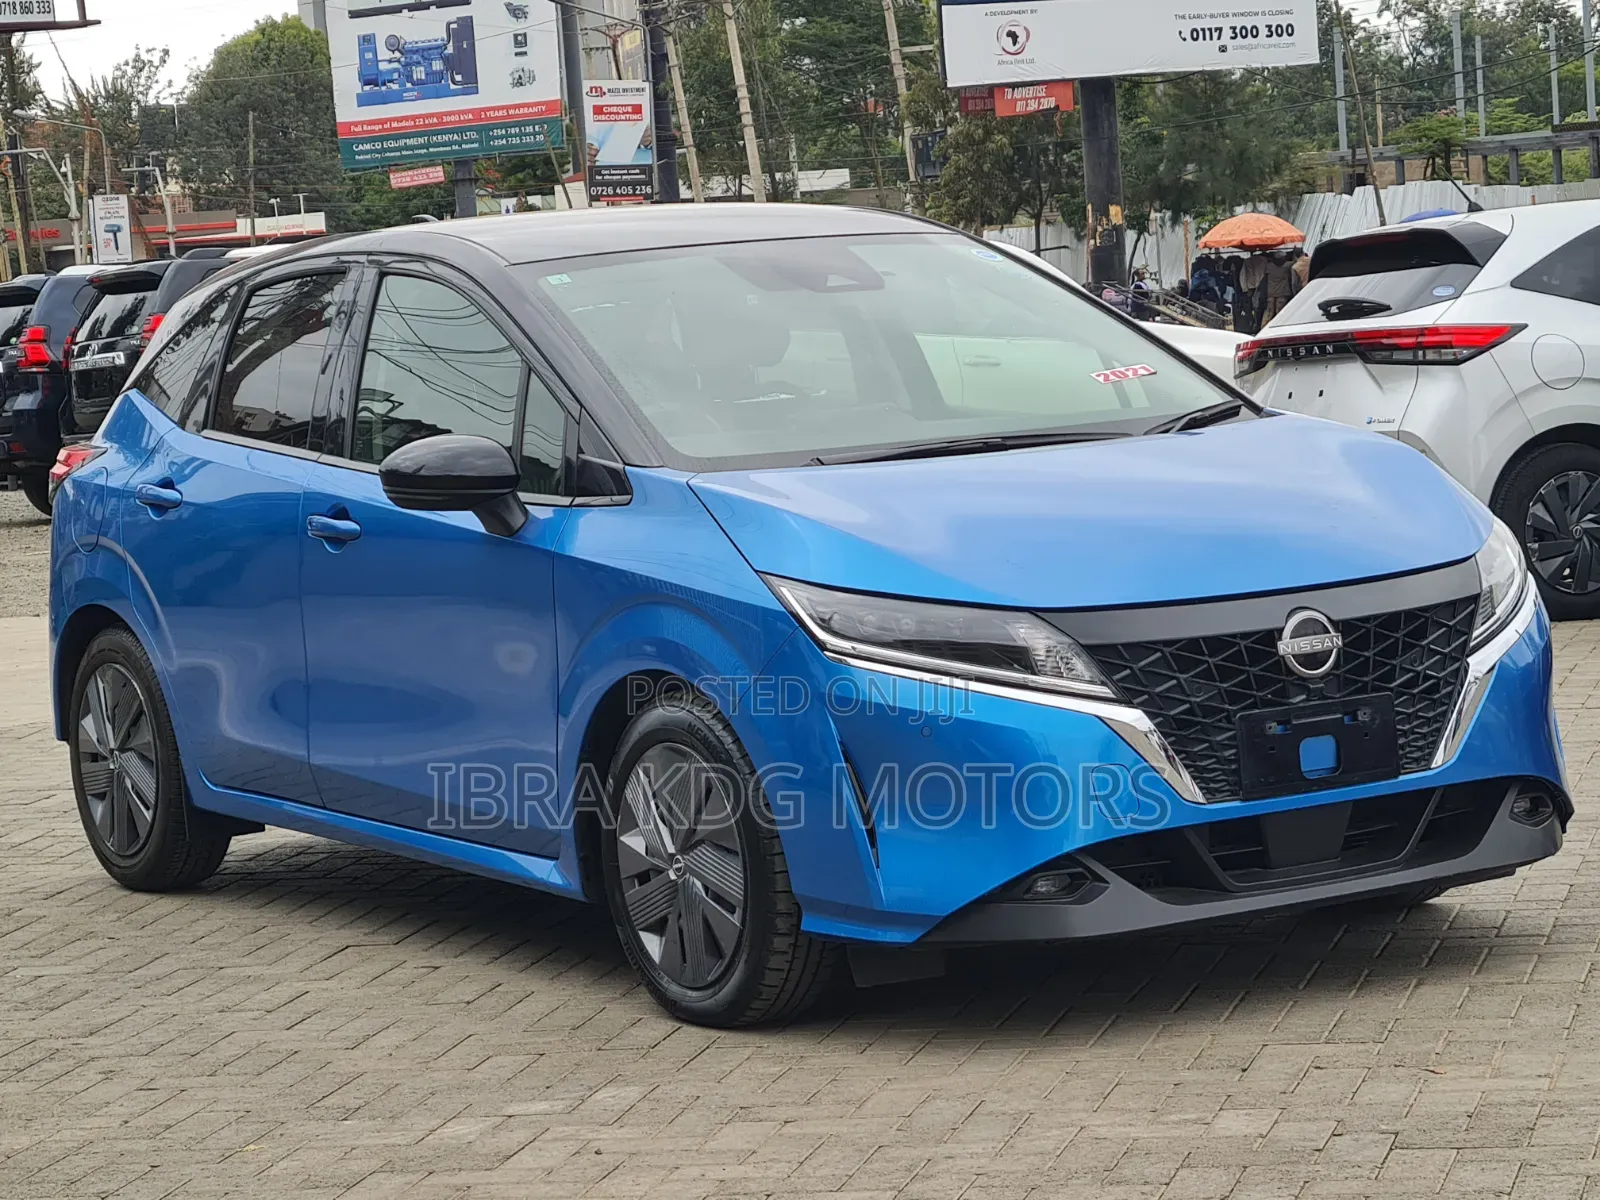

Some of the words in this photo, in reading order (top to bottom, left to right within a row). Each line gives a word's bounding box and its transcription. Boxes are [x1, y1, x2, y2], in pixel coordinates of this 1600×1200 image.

[19, 1, 34, 15] 860
[36, 0, 51, 14] 333
[1188, 12, 1230, 20] EARLY-BUYER
[1231, 10, 1260, 18] WINDOW
[1190, 26, 1223, 42] 0117
[1229, 24, 1260, 40] 300
[1265, 23, 1295, 38] 300
[1004, 88, 1012, 100] TO
[1013, 85, 1048, 98] ADVERTISE
[486, 109, 508, 117] YEARS
[508, 105, 547, 115] WARRANTY
[602, 105, 633, 113] CHEQUE
[593, 113, 642, 121] DISCOUNTING
[350, 124, 362, 133] Full
[363, 124, 382, 132] Range
[391, 120, 414, 128] Models
[352, 140, 382, 151] CAMCO
[383, 135, 429, 148] EQUIPMENT
[429, 132, 461, 144] (KENYA)
[462, 131, 479, 140] LTD.
[590, 186, 614, 195] 0726
[615, 185, 633, 195] 405
[635, 185, 652, 194] 236
[1267, 344, 1334, 359] NISSAN
[1279, 636, 1342, 654] NISSAN
